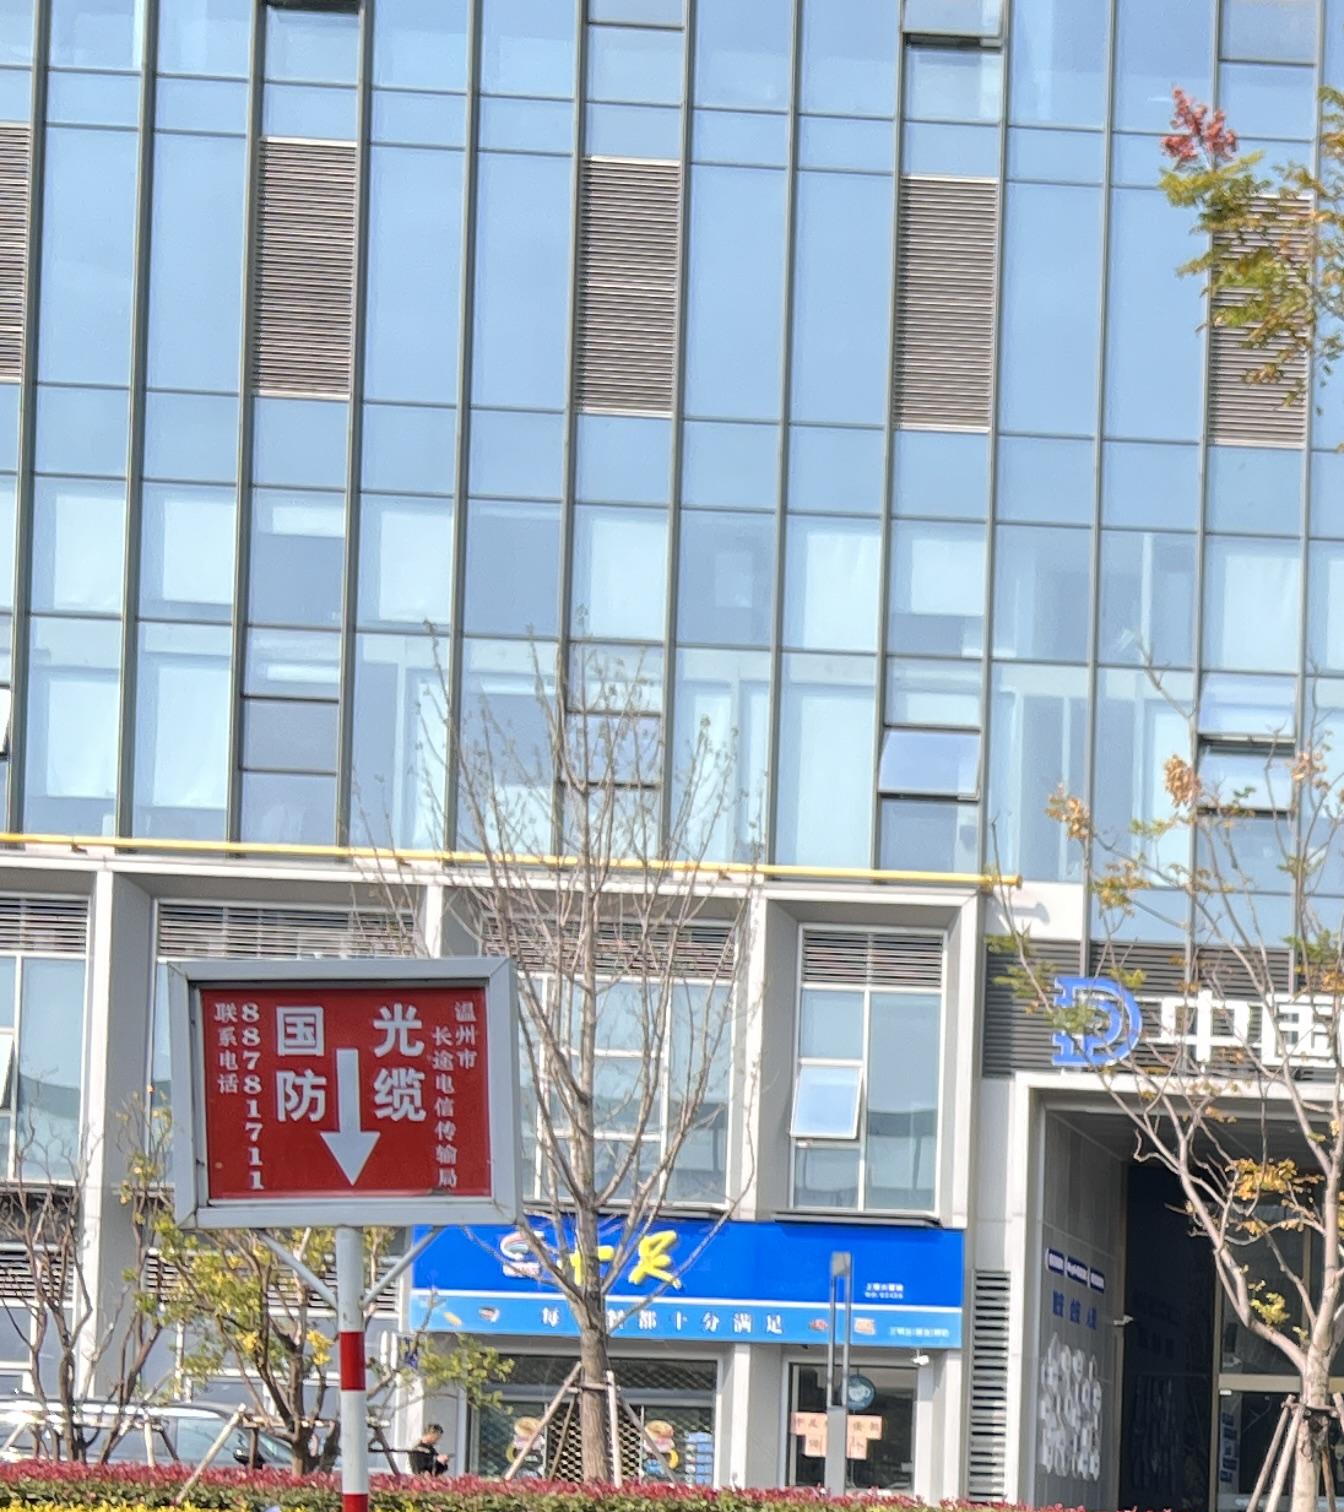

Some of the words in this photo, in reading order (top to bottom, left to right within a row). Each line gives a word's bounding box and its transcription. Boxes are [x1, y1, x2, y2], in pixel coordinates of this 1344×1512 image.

[214, 1002, 239, 1094] 联系电话
[276, 1005, 327, 1122] 国防
[373, 1002, 427, 1121] 光缆
[455, 1001, 478, 1070] 温州市
[241, 1002, 264, 1190] 88781711
[431, 1026, 458, 1187] 长途电信传输局
